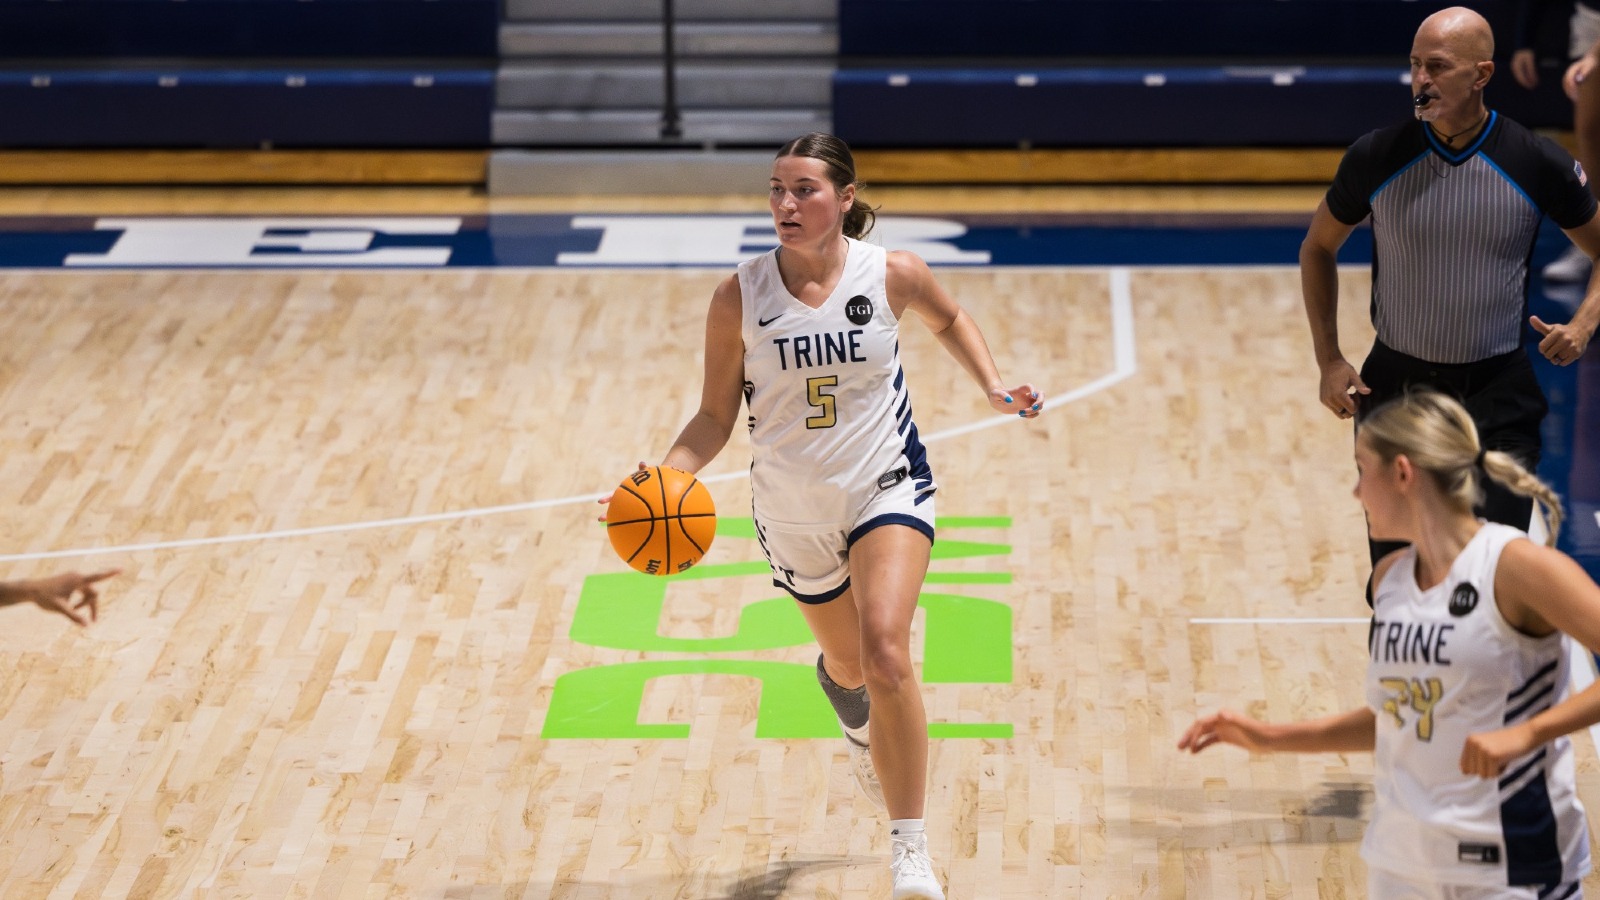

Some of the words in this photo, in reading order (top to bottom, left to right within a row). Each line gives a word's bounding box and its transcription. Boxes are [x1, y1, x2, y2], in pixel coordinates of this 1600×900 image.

[848, 304, 872, 317] FGI
[773, 329, 867, 371] TRINE
[806, 375, 839, 430] 5
[1373, 621, 1455, 666] TRINE
[1379, 676, 1444, 743] 24
